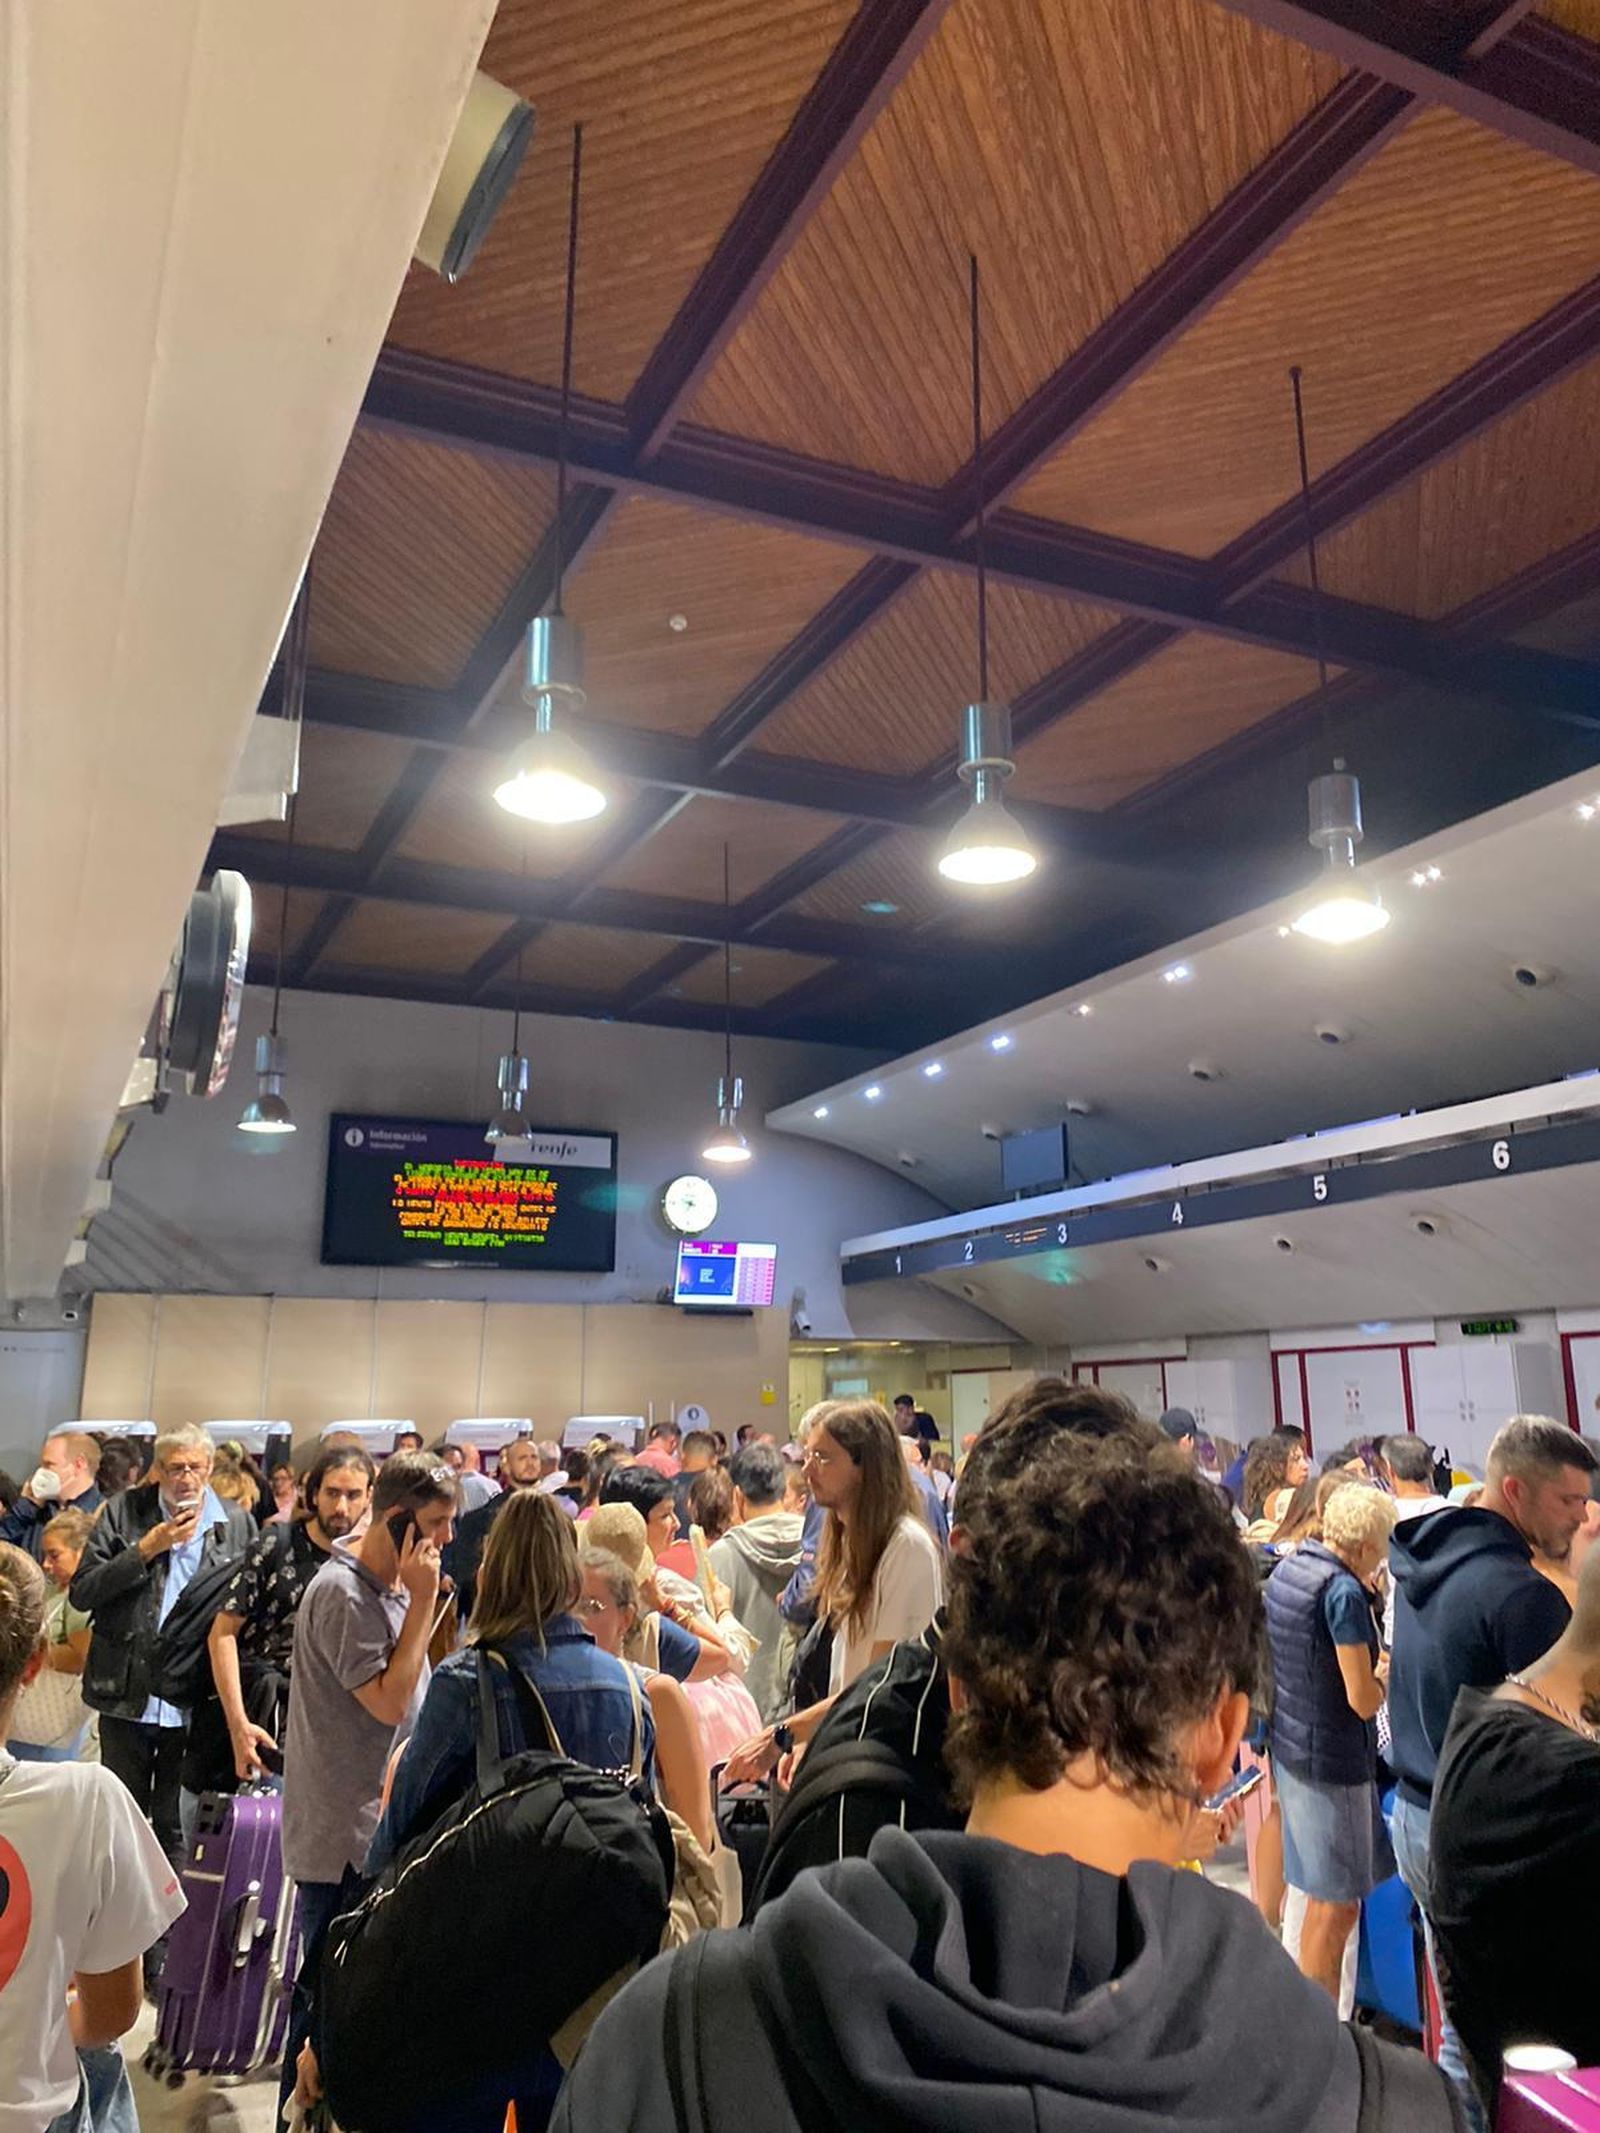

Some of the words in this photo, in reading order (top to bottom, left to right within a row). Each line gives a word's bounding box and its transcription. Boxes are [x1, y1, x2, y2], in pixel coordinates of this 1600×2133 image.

[530, 1141, 577, 1159] renfe
[1492, 1140, 1510, 1170] 6
[1313, 1175, 1327, 1201] 5
[1172, 1202, 1184, 1224] 4
[1057, 1224, 1067, 1244] 3
[964, 1242, 973, 1260] 2
[895, 1255, 902, 1274] 1
